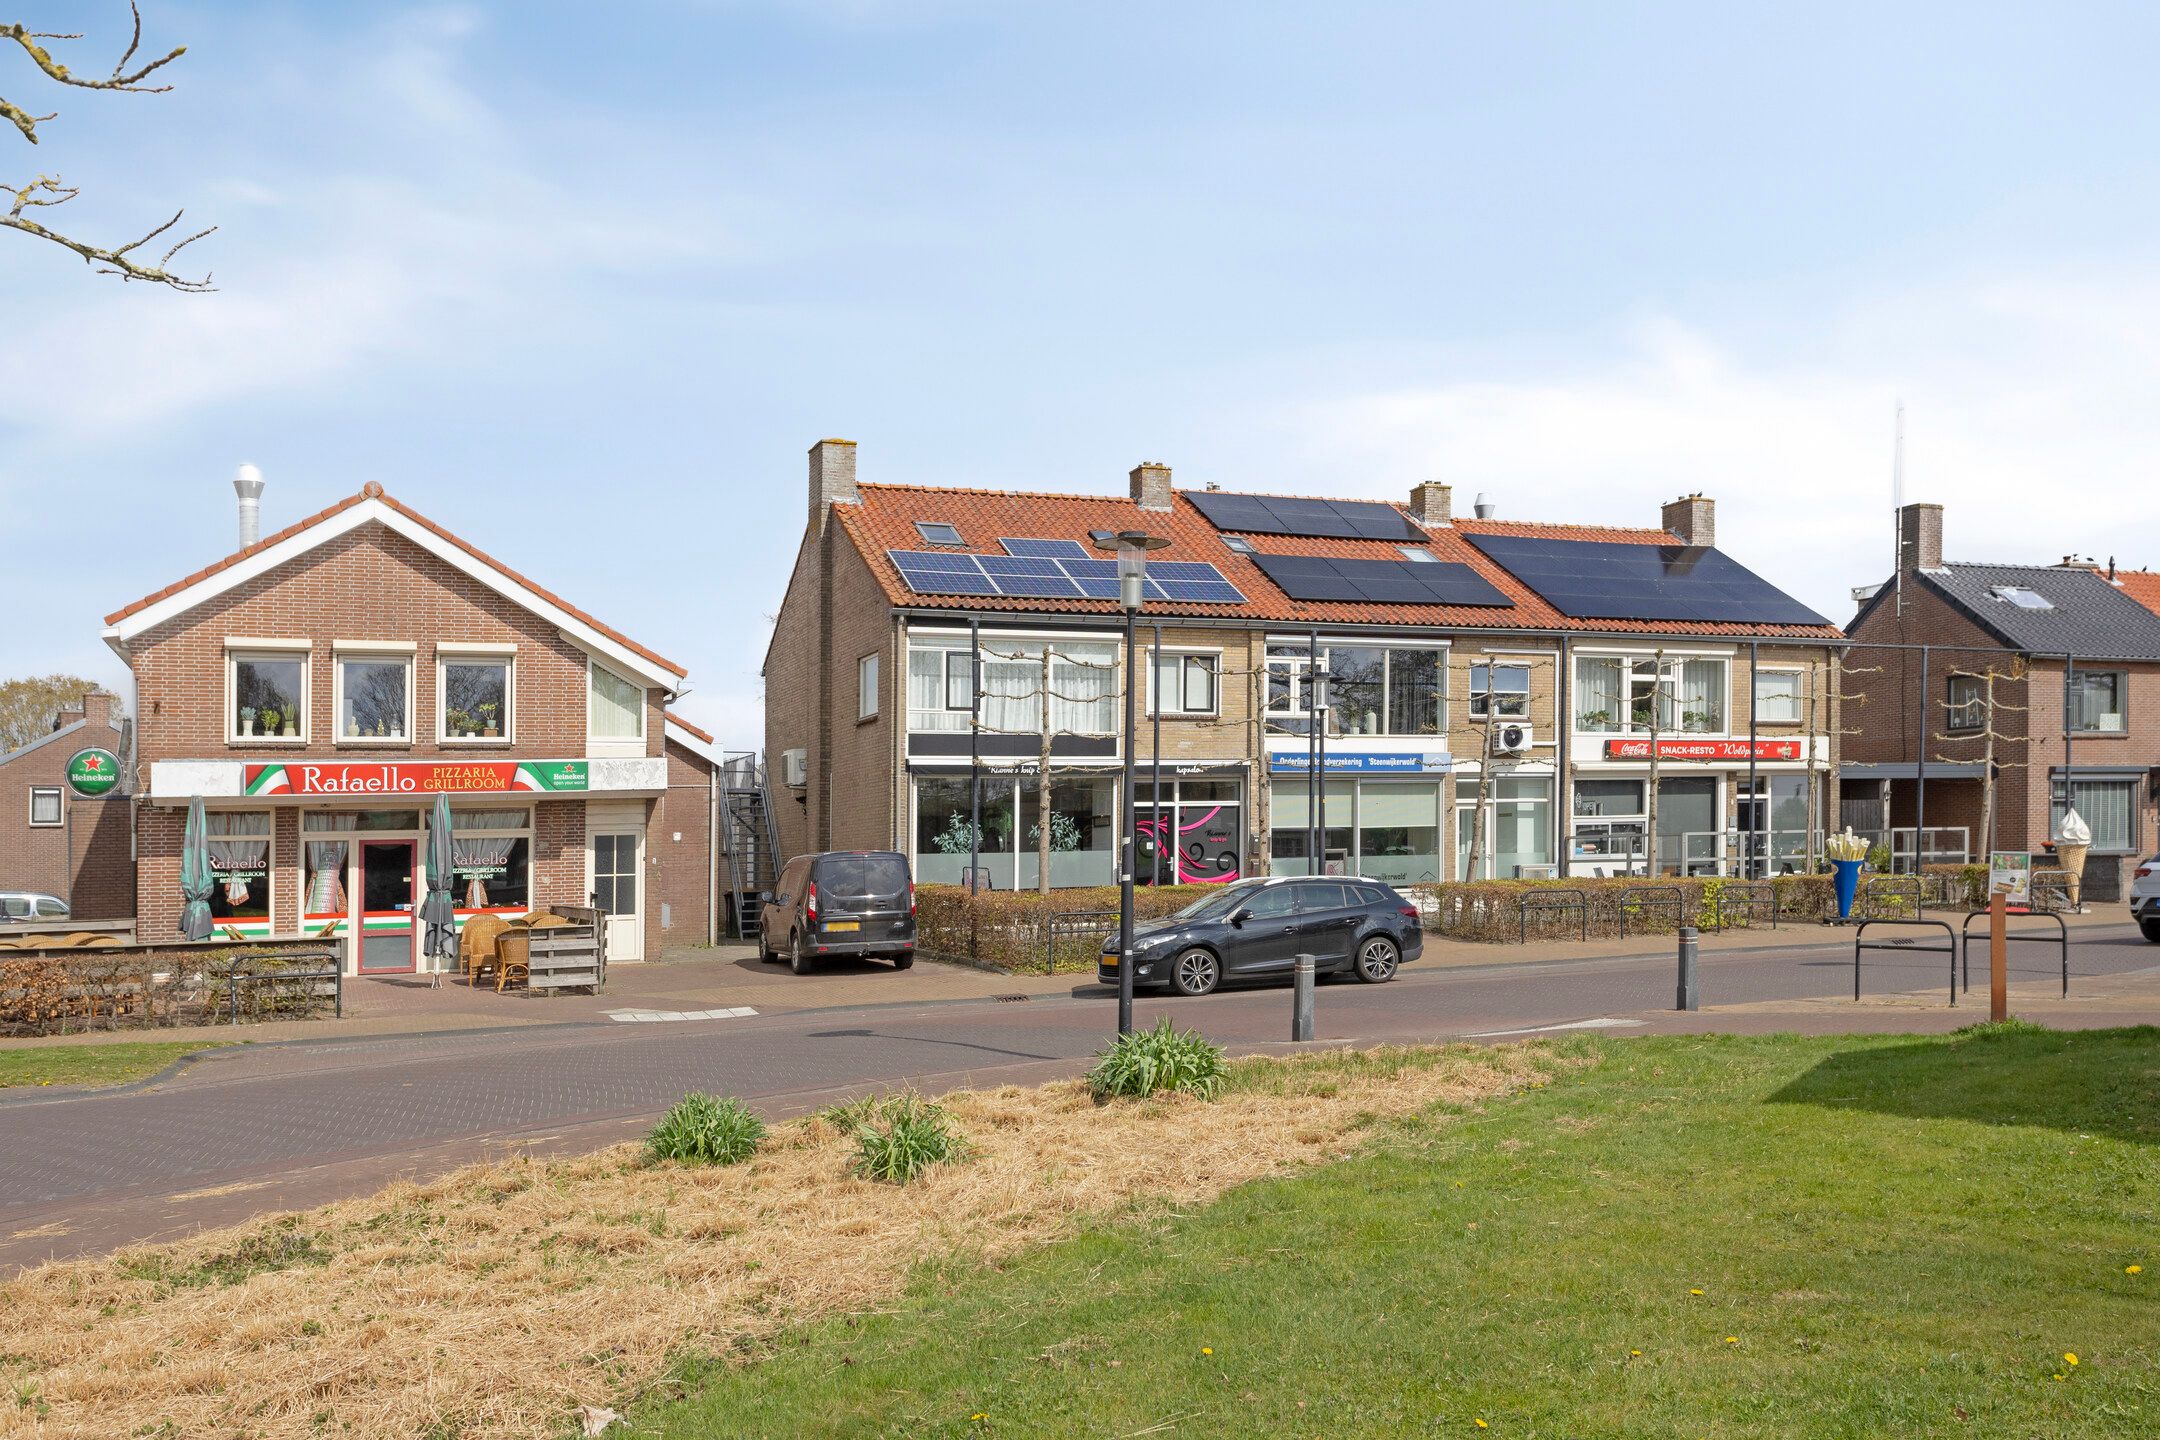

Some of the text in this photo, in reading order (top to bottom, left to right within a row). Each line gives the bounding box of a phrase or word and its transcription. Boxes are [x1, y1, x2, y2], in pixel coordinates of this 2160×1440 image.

[72, 774, 115, 782] Heineken
[432, 767, 497, 778] PIZZARIA
[302, 766, 416, 793] Rafaello
[423, 778, 506, 790] GRILLROOM
[209, 855, 267, 870] Rafaello
[453, 851, 508, 866] Rafaello
